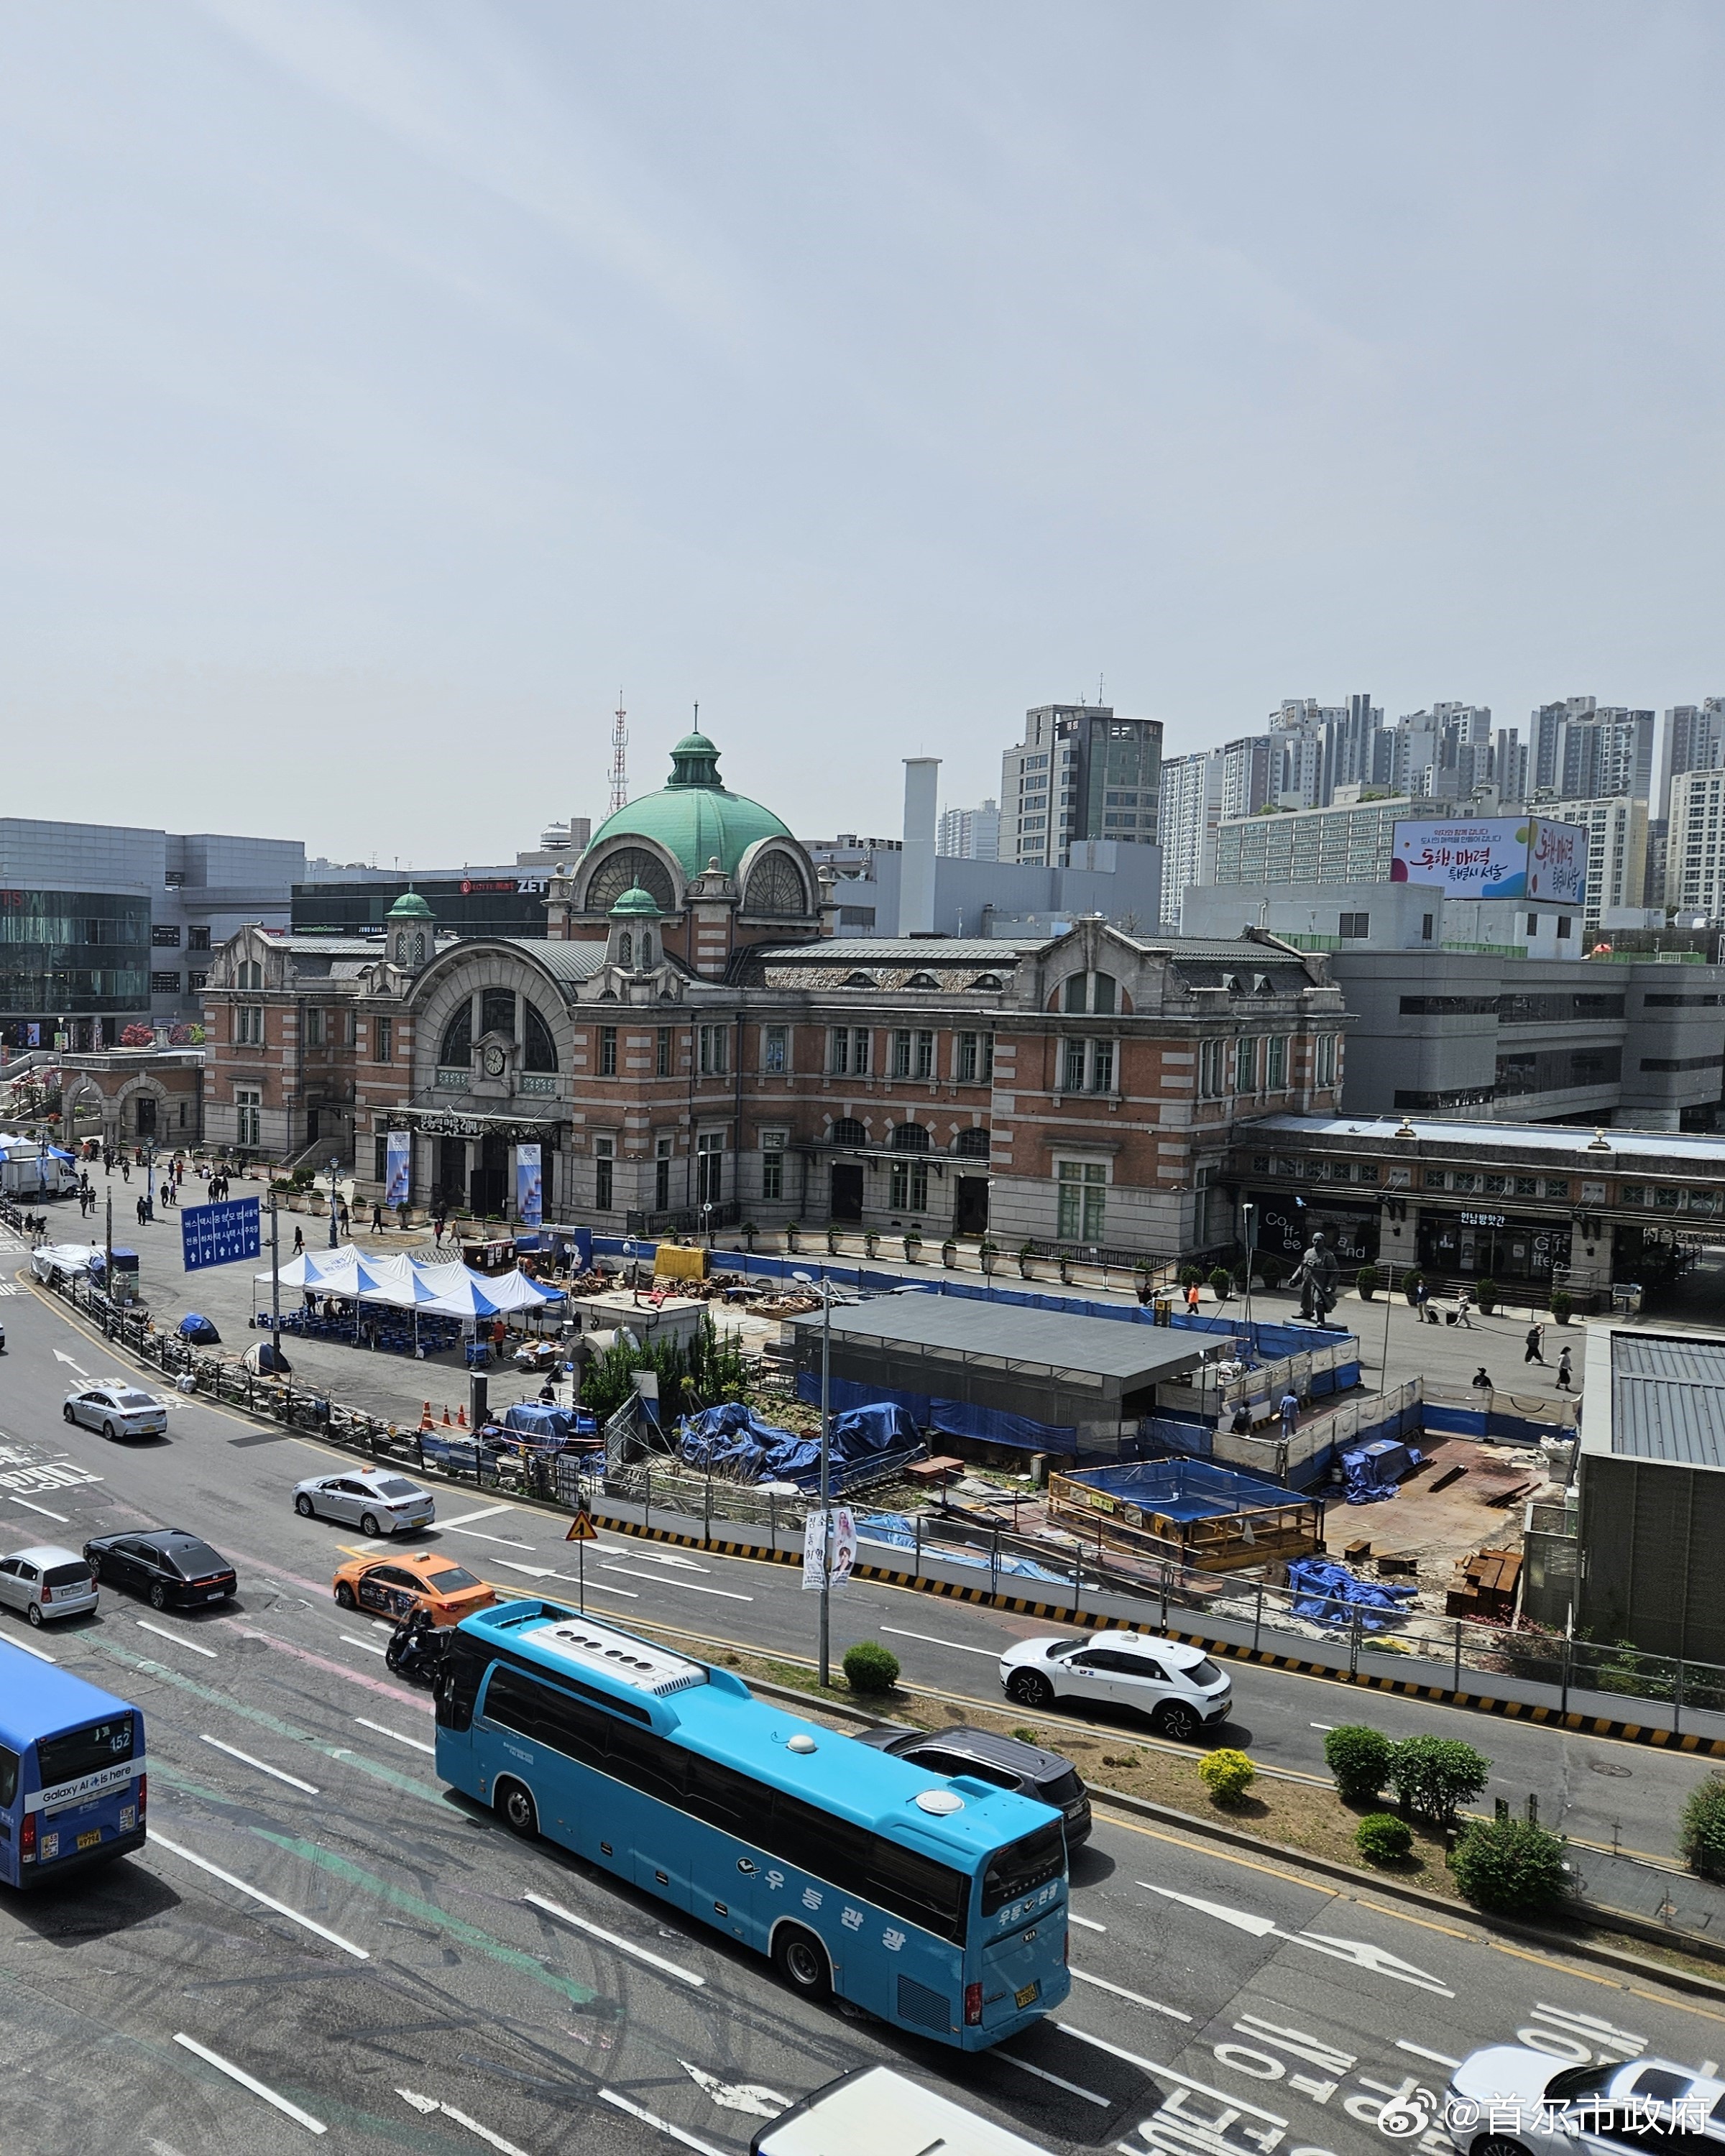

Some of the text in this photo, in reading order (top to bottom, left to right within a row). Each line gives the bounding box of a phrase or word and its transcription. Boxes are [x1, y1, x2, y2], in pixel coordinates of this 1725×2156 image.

[1448, 864, 1508, 882] 특별시 서울
[244, 1208, 258, 1218] 서울역
[185, 1220, 198, 1229] 버스
[200, 1217, 212, 1225] 택시
[1460, 1212, 1506, 1227] 연남방앗간
[214, 1231, 229, 1240] 택시
[229, 1227, 243, 1238] 택시
[244, 1225, 259, 1235] 주차장
[1643, 1226, 1689, 1245] 서울역
[185, 1236, 198, 1245] 전용
[201, 1234, 213, 1243] 하차
[111, 1733, 131, 1751] 152
[43, 1766, 131, 1802] Galaxy AI is here
[999, 1883, 1058, 1926] 우등 관광
[1024, 1930, 1036, 1942] KIA
